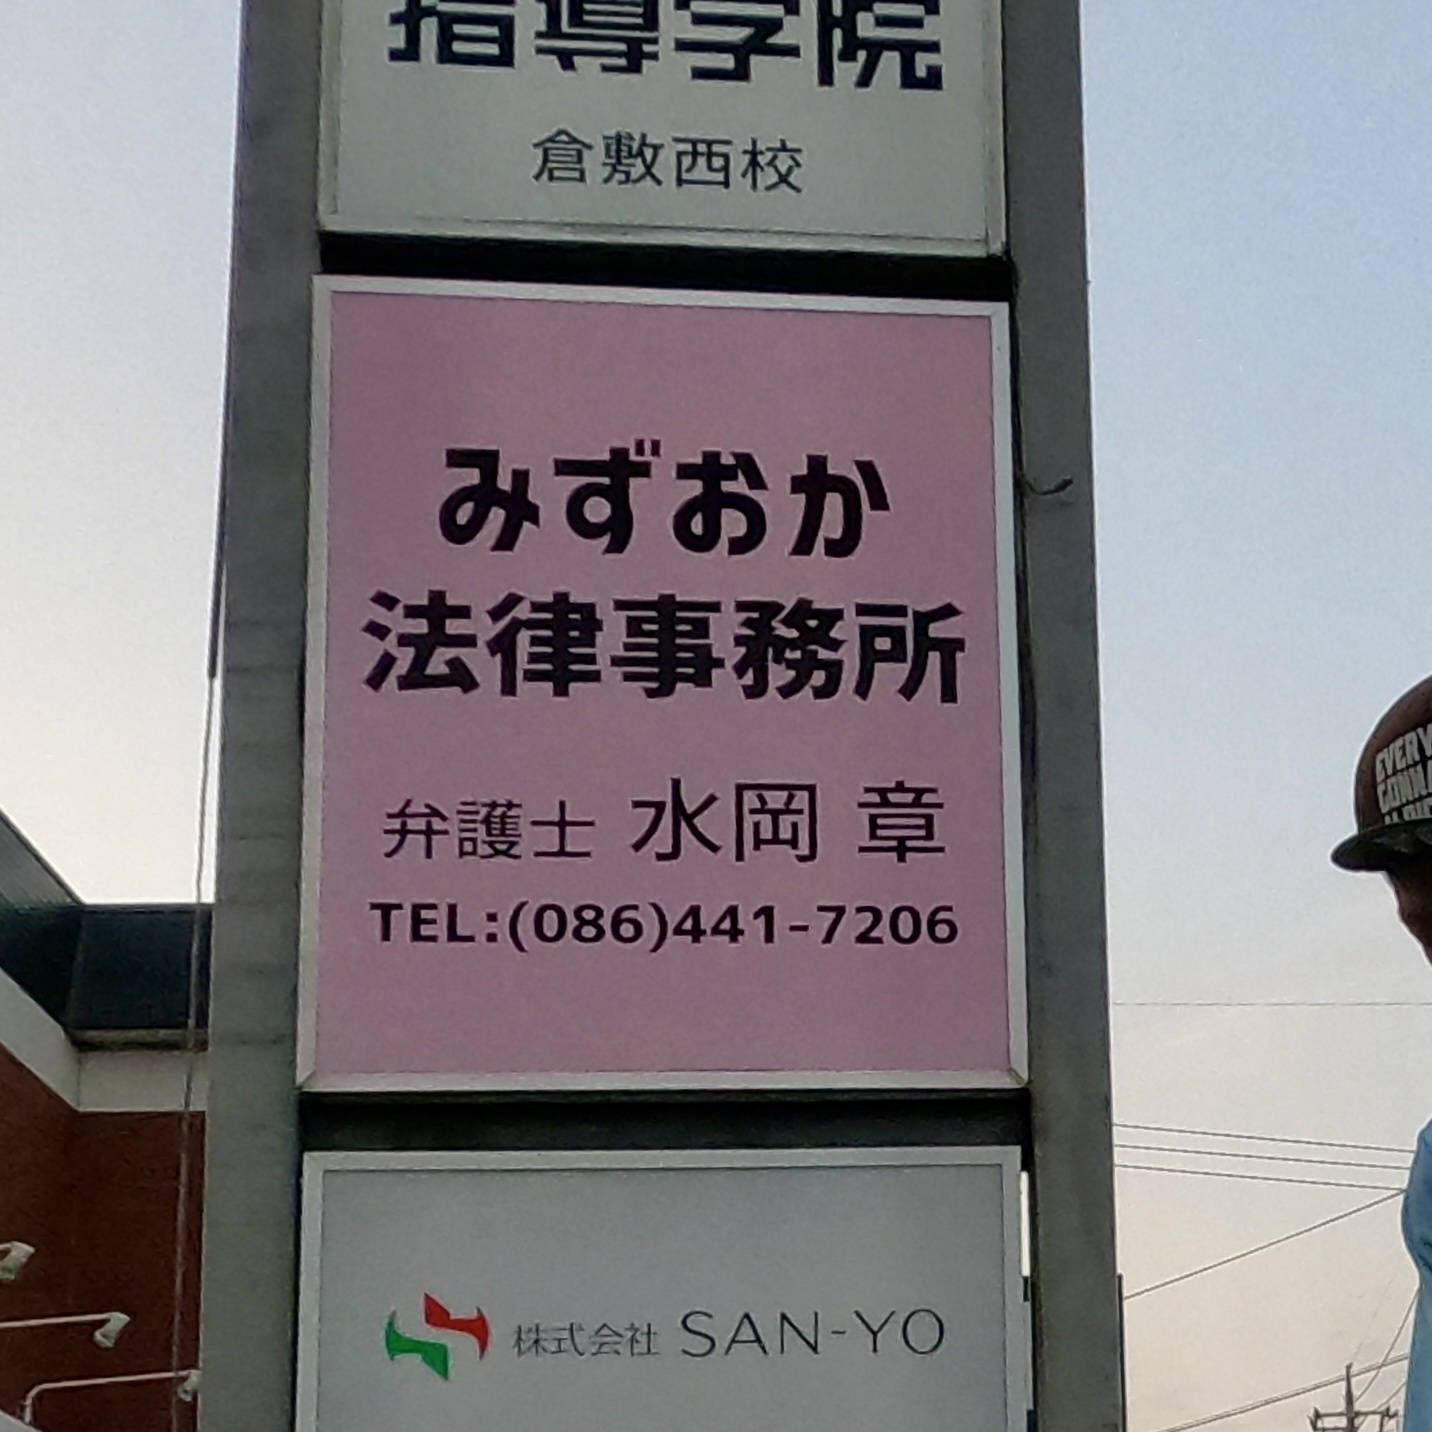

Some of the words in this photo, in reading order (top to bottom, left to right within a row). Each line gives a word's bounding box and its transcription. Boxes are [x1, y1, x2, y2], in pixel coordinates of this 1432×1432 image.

[532, 128, 803, 193] 倉敷西校
[438, 438, 890, 558] みずおか
[362, 589, 965, 703] 法律事務所
[383, 798, 594, 861] 弁護士
[630, 777, 819, 863] 水岡
[856, 780, 945, 863] 章
[370, 901, 959, 954] TEL:(086)441-7206
[513, 1321, 661, 1359] 株式会社
[680, 1307, 945, 1358] SAN-YO
